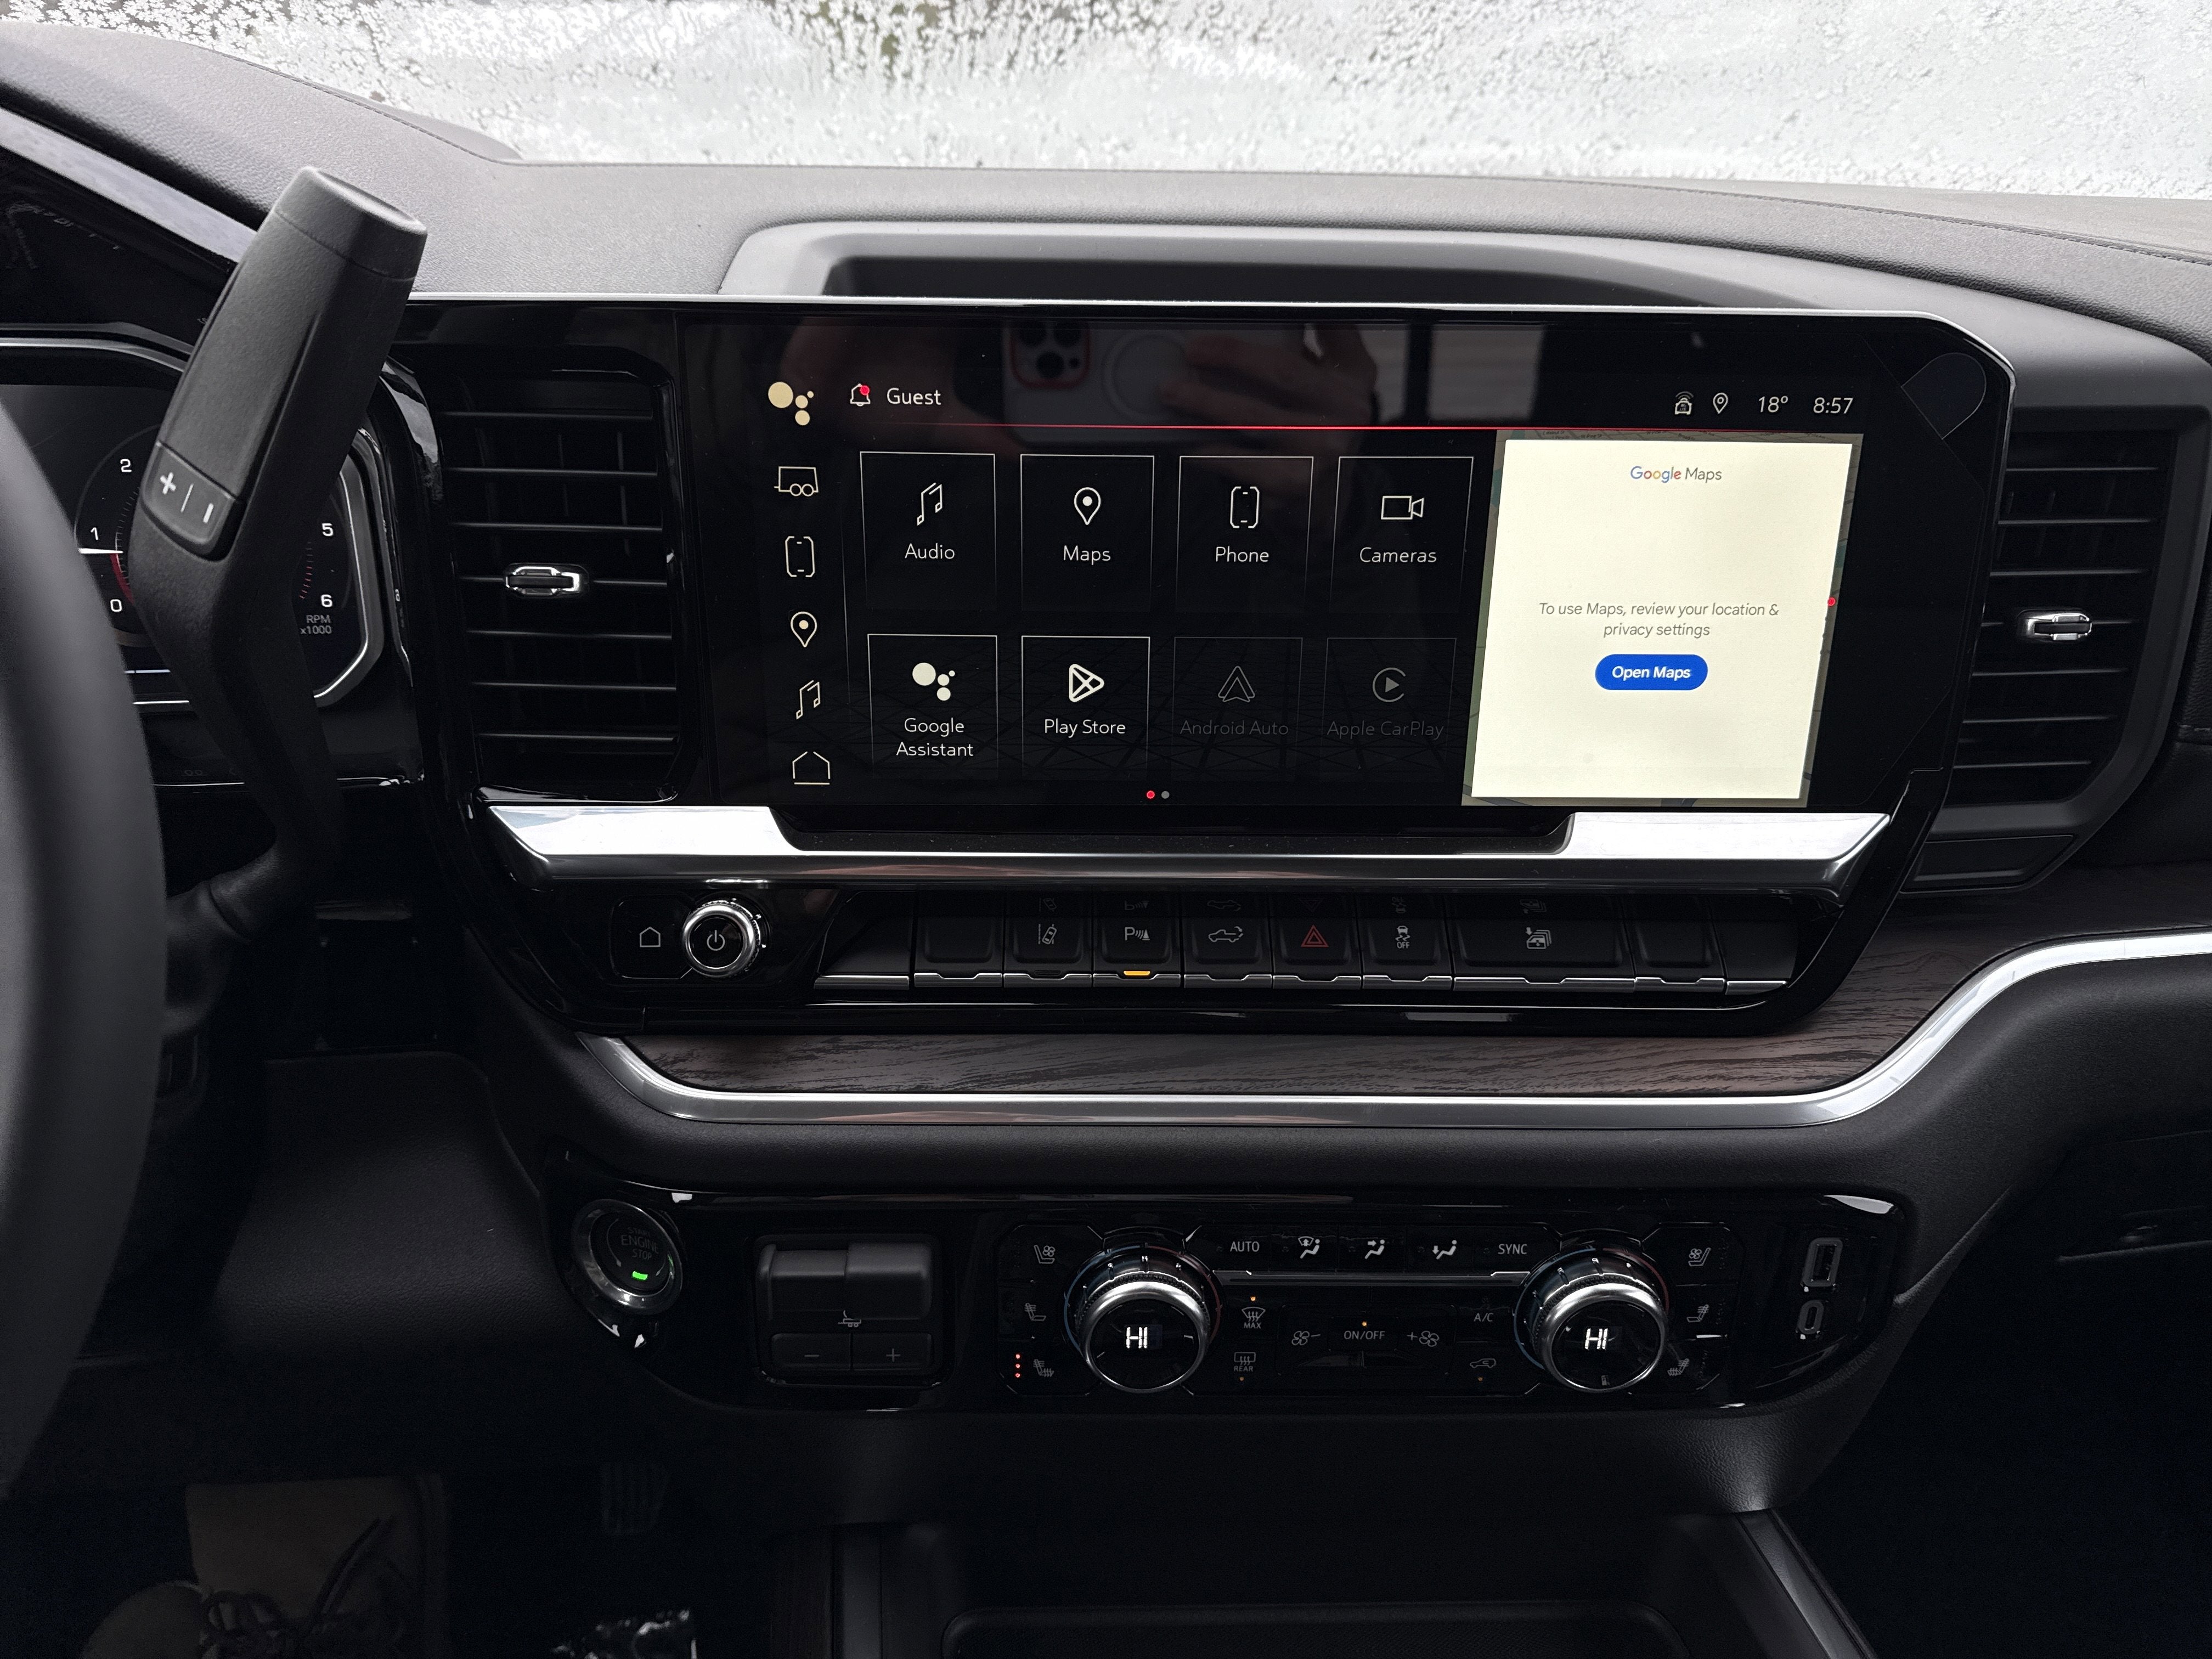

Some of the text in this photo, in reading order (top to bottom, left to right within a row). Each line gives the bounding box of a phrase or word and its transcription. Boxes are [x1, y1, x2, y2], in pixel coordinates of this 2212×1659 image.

[887, 387, 941, 405] Guest
[1813, 397, 1853, 414] 8:57
[120, 459, 132, 472] 2
[1630, 465, 1722, 484] Google Maps
[91, 527, 99, 540] 1
[321, 523, 334, 537] 5
[904, 543, 955, 560] Audio
[1063, 545, 1111, 566] Maps
[1216, 545, 1269, 562] Phone
[1359, 546, 1437, 563] Cameras
[110, 599, 122, 612] 0
[320, 594, 333, 607] 6
[1539, 602, 1779, 618] To use Maps, review your location &
[306, 614, 331, 624] RPM
[300, 625, 332, 634] x1000
[1603, 622, 1710, 639] privacy settings
[1612, 665, 1691, 681] Open Maps
[904, 717, 964, 737] Google
[1045, 718, 1126, 738] Play Store
[1180, 719, 1289, 735] Android Auto
[1327, 720, 1444, 740] Apple CarPlay
[896, 741, 974, 757] Assistant
[621, 1234, 659, 1255] ENGINE
[1229, 1241, 1260, 1252] AUTO
[1498, 1243, 1527, 1255] SYNC
[631, 1248, 652, 1260] STOP
[1244, 1320, 1261, 1329] MAX
[1474, 1312, 1494, 1322] A/C
[1126, 1327, 1148, 1348] HI
[1344, 1330, 1385, 1340] ON/OFF
[1584, 1328, 1609, 1350] HI
[1233, 1363, 1254, 1372] REAR
